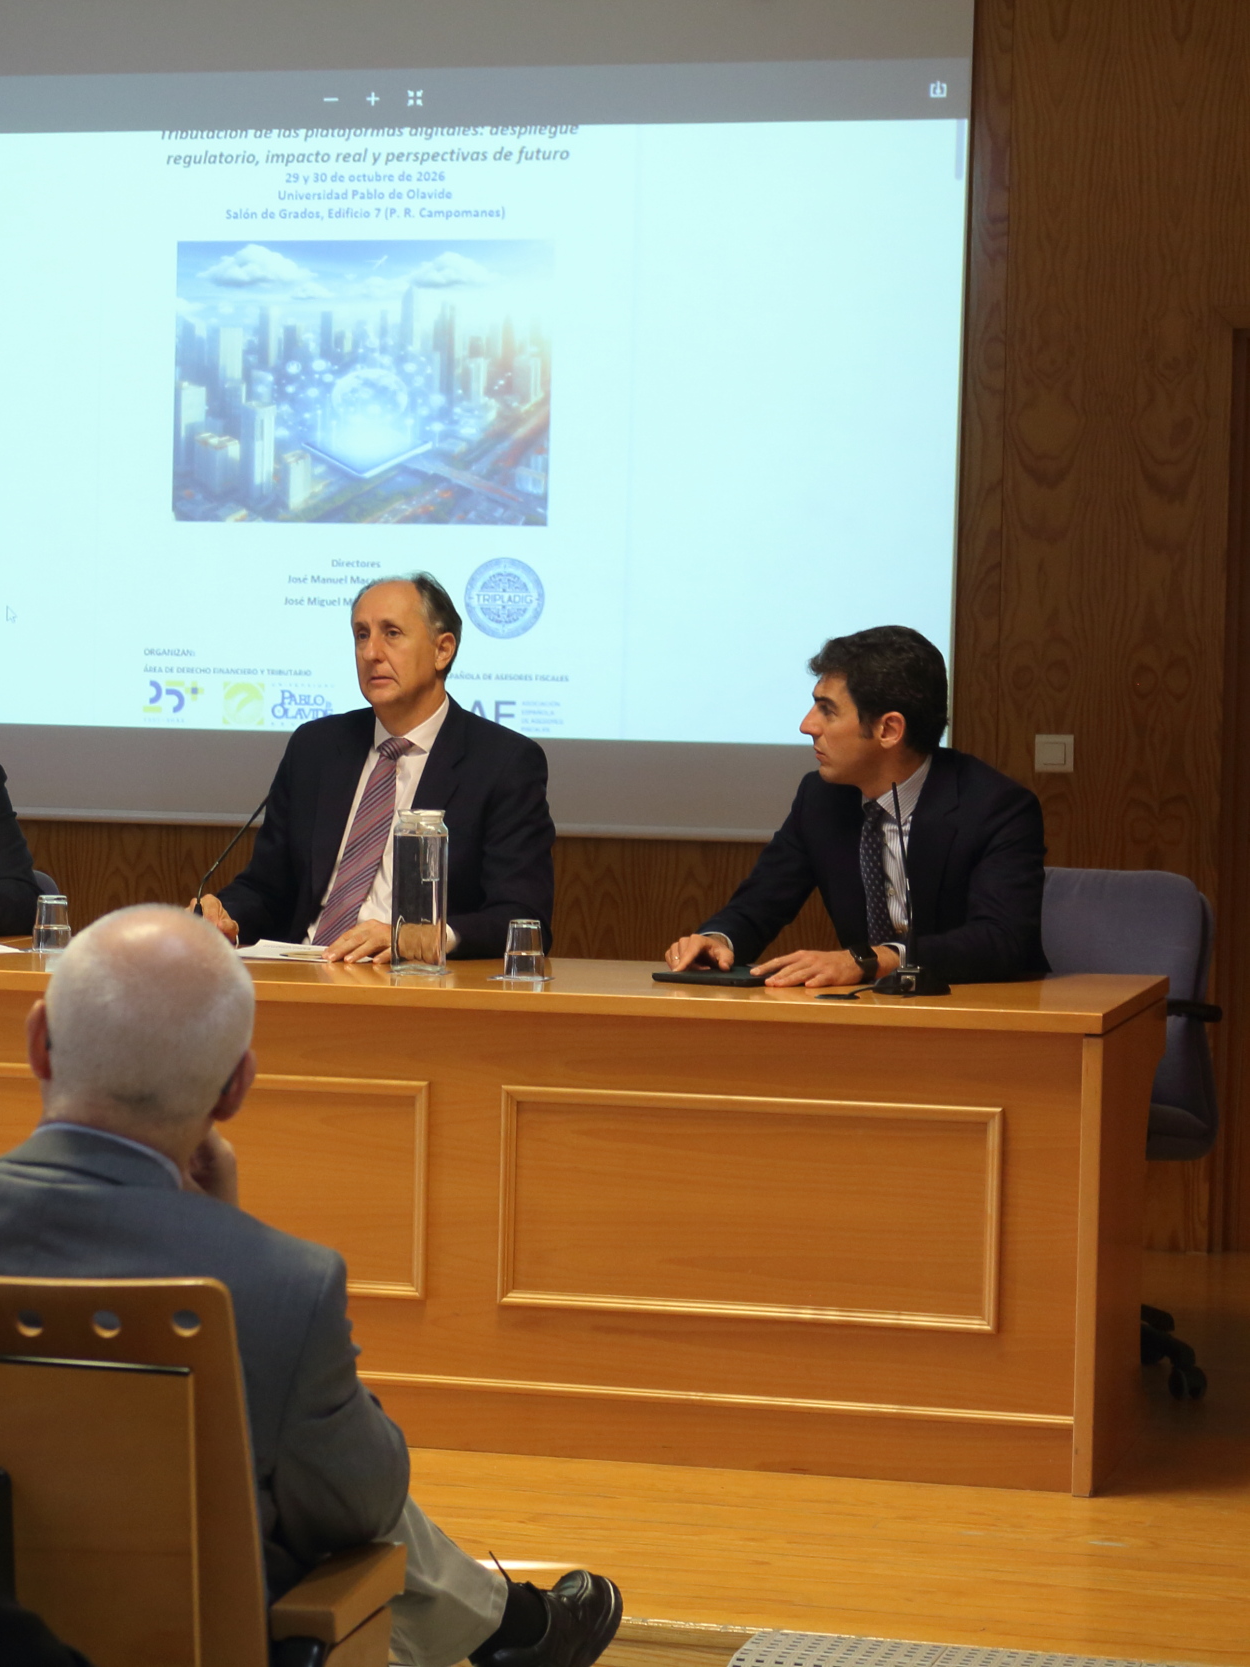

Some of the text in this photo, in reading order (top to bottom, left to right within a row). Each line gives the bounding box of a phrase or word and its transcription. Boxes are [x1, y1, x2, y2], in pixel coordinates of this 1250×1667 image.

[166, 146, 570, 168] regulatorio, impacto real y perspectivas de futuro
[285, 171, 446, 185] 29 y 30 de octubre de 2026
[278, 188, 453, 201] Universidad Pablo de Olavide
[225, 205, 506, 221] Salón de Grados, Edificio 7 (P. R. Campomanes)
[331, 557, 381, 568] Directores
[288, 574, 308, 584] José
[310, 575, 348, 585] Manuel
[284, 596, 305, 606] José
[307, 597, 341, 608] Miguel
[476, 593, 534, 604] TRIPLADIG
[176, 666, 211, 675] DERECHO
[213, 667, 259, 676] FINANCIERO
[280, 689, 325, 706] PABLO
